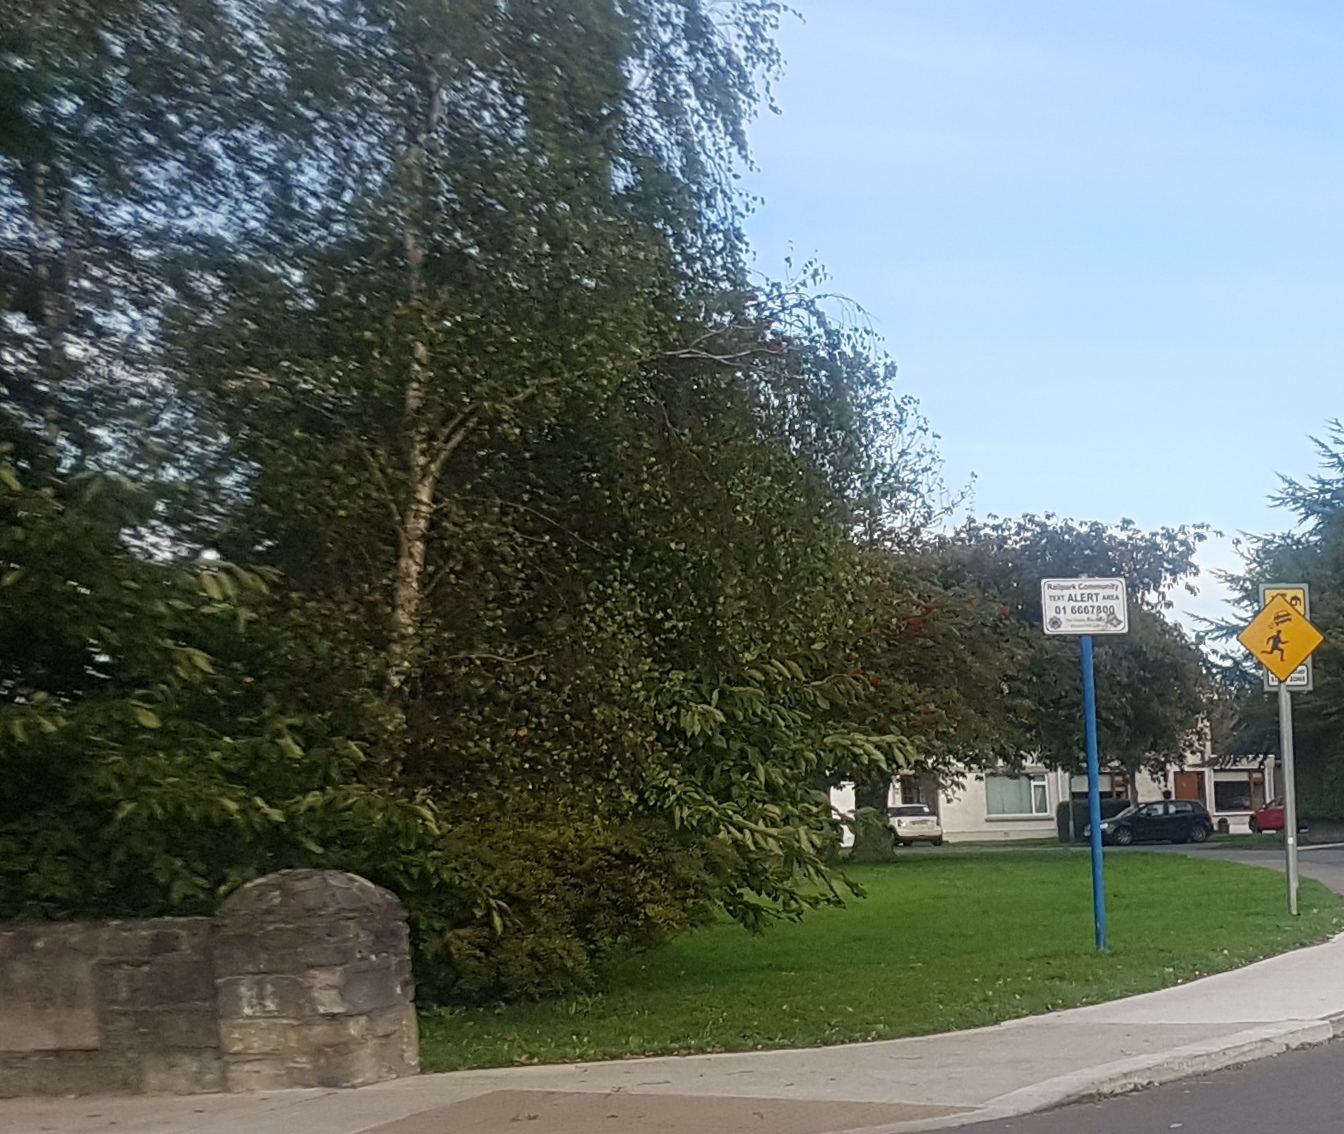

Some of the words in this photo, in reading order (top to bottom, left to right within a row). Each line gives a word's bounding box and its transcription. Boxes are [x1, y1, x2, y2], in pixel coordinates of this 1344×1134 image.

[1078, 583, 1119, 591] Community
[1067, 593, 1100, 602] ALERT
[1054, 605, 1067, 615] 01
